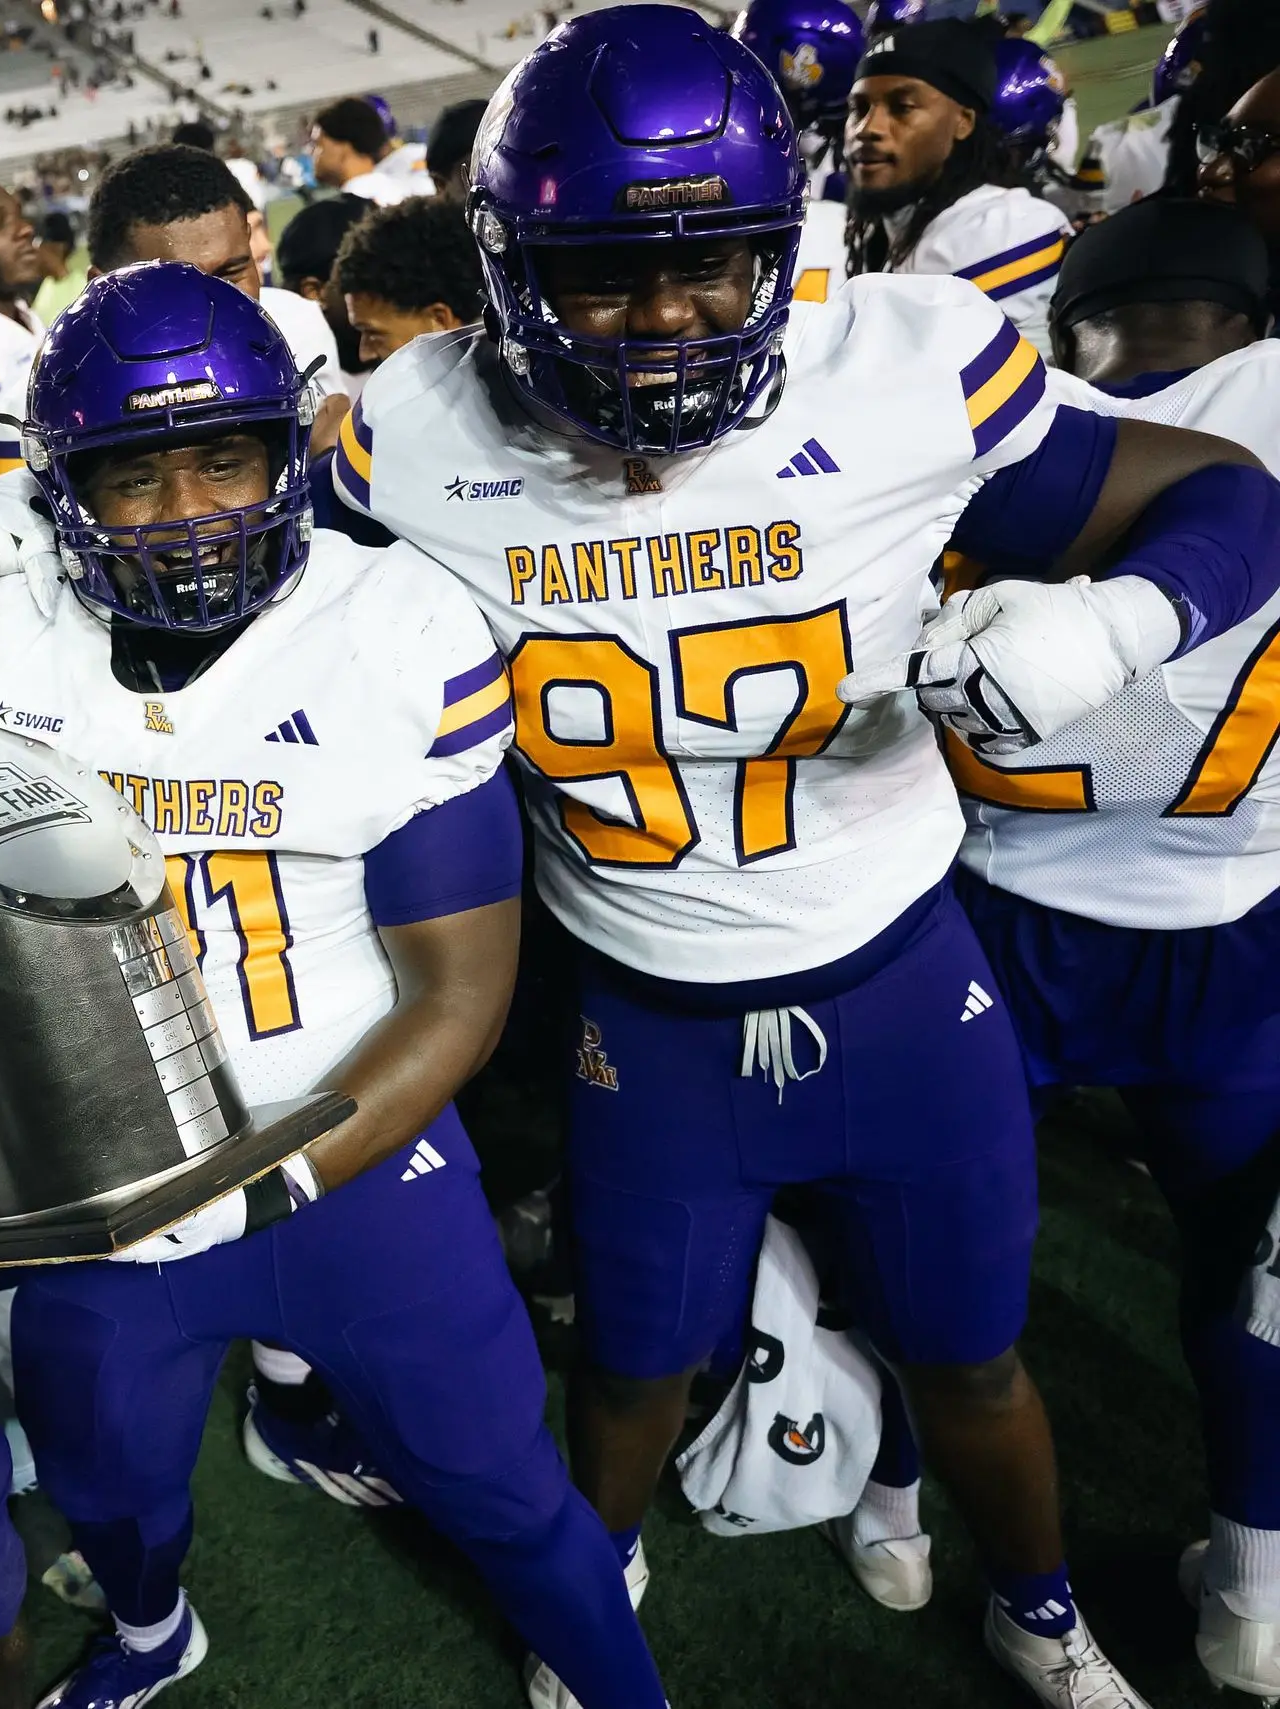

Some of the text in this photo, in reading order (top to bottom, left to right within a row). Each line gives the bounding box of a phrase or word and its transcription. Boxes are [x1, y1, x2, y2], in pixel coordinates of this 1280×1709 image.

[626, 183, 723, 207] PANTHER
[654, 395, 700, 411] Ridell
[470, 479, 522, 499] SWAC
[505, 520, 803, 605] PANTHERS
[13, 711, 64, 733] SWAC
[508, 598, 854, 870] 97
[98, 770, 284, 838] THERS
